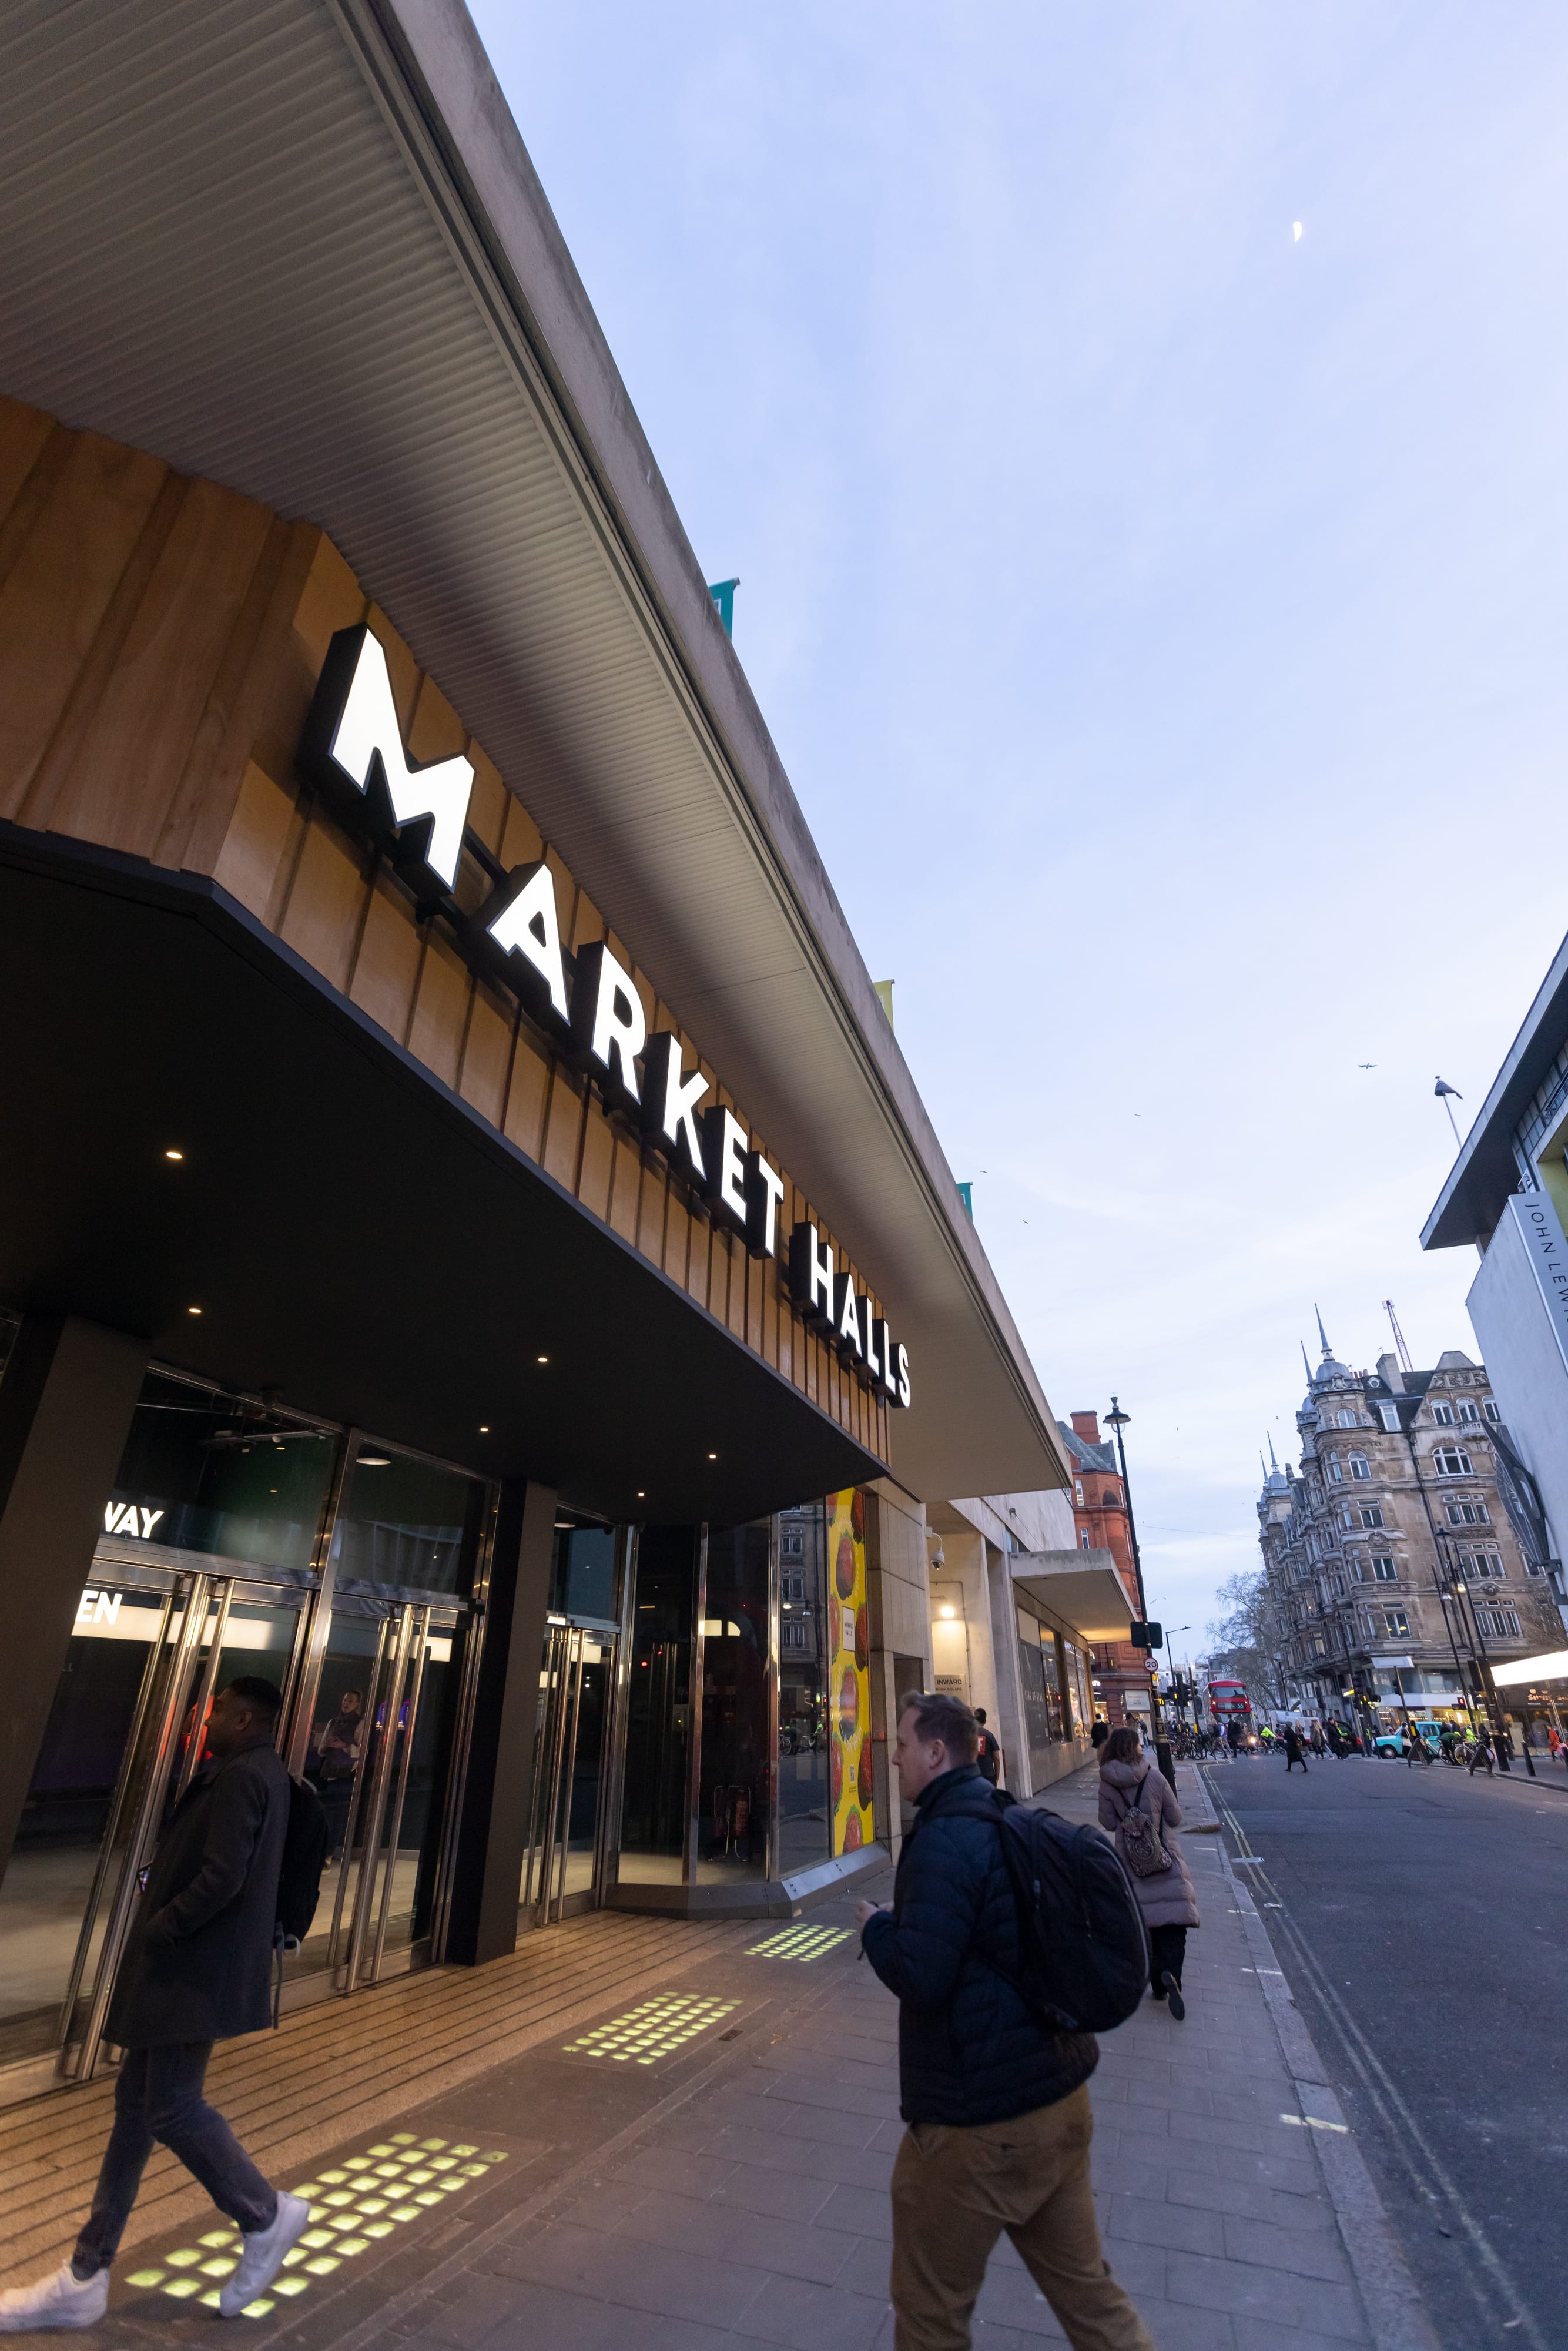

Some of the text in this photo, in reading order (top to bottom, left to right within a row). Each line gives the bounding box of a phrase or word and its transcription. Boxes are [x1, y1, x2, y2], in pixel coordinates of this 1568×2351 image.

[327, 627, 912, 1408] MARKET HALLS
[1525, 1204, 1568, 1322] JOHN LEW
